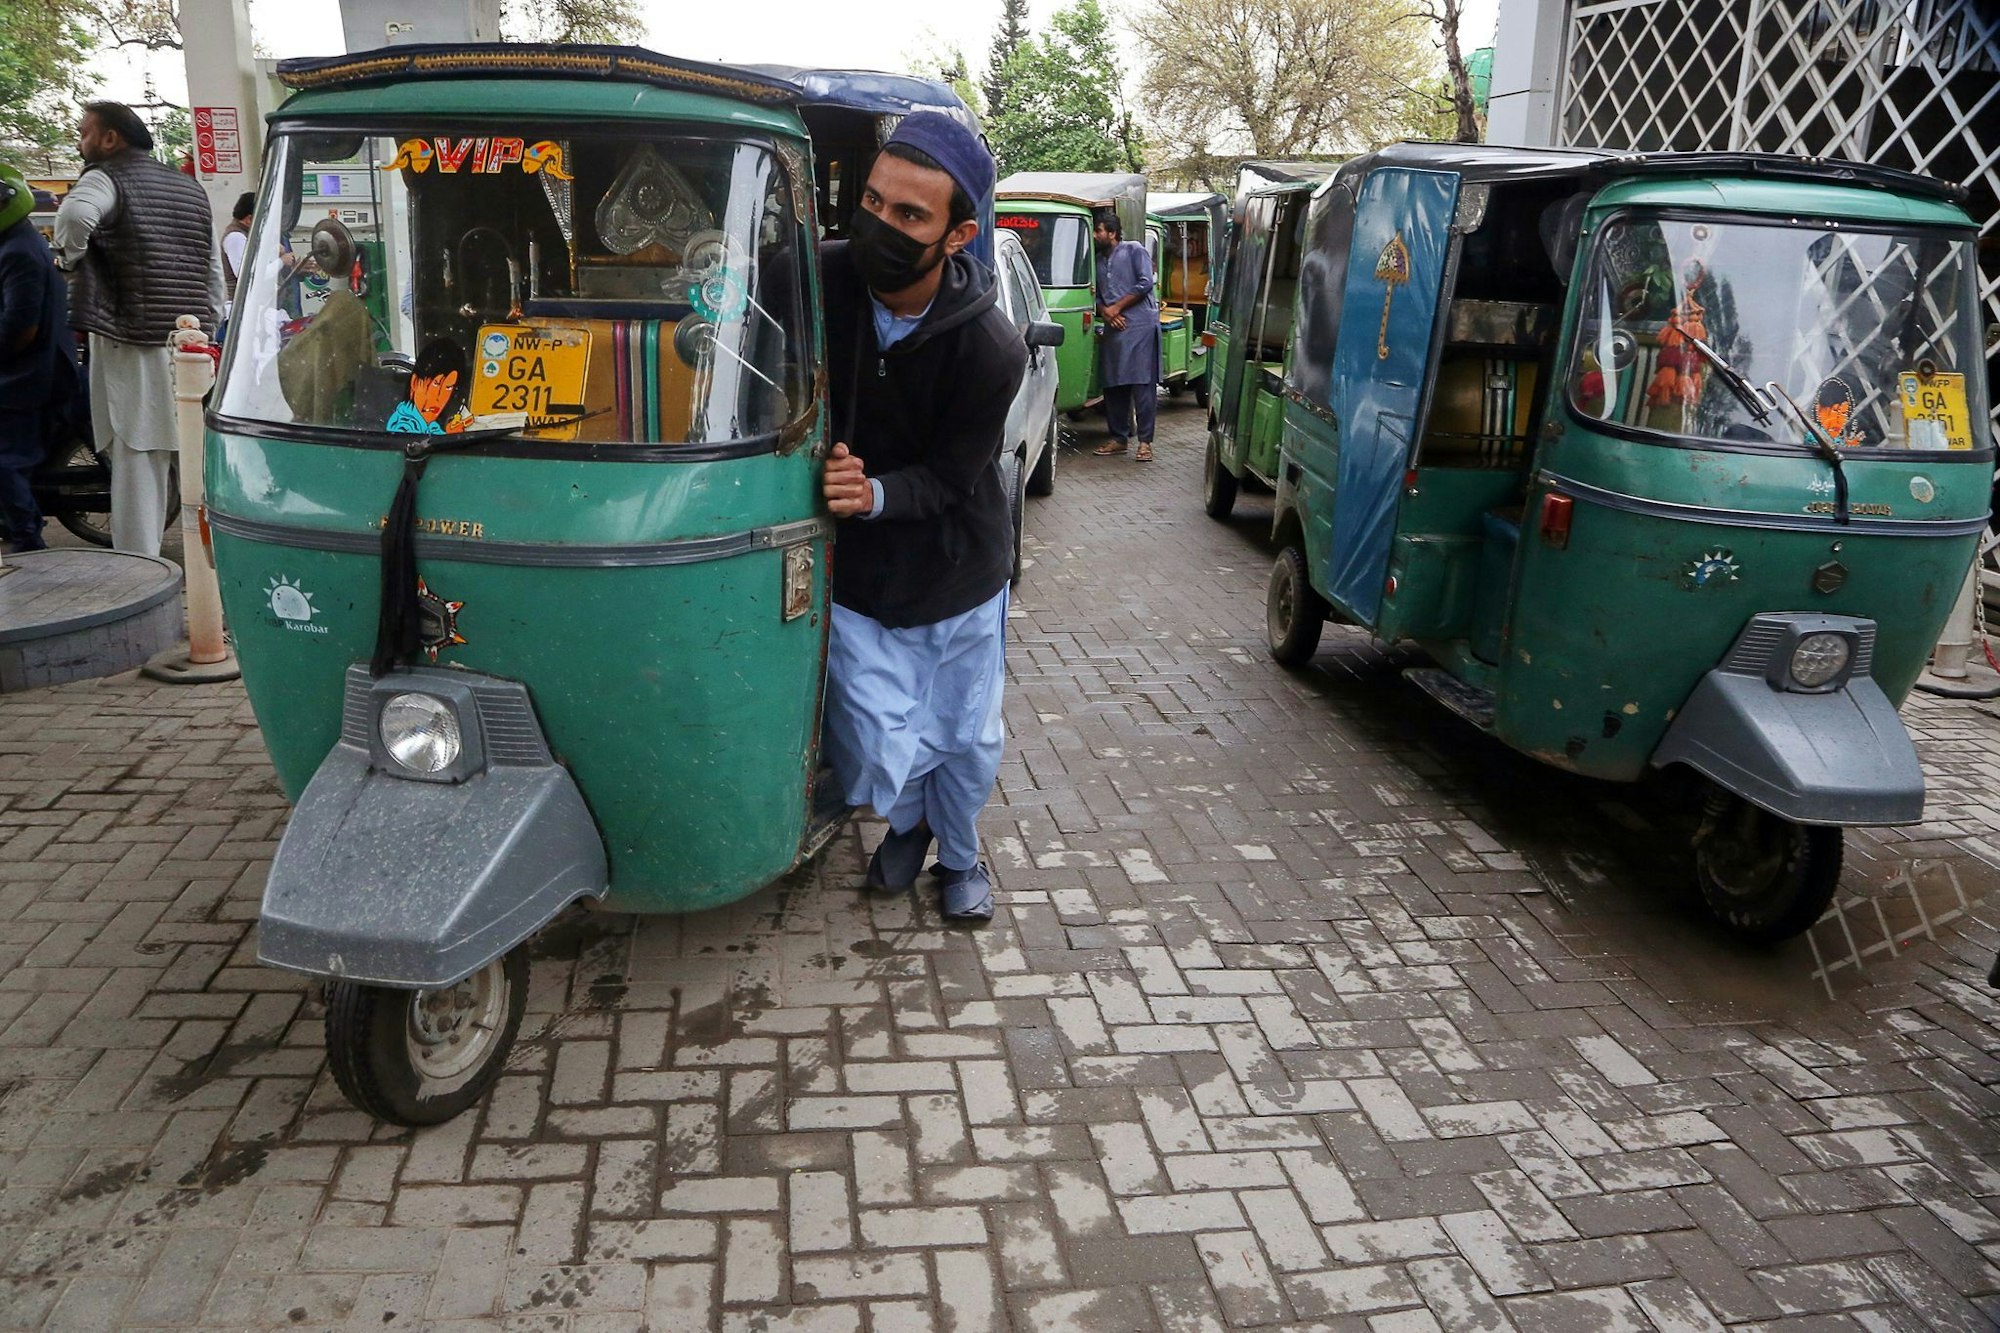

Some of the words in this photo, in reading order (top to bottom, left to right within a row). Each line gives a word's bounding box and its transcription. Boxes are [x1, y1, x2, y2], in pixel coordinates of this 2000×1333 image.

[434, 137, 524, 173] VIP
[514, 338, 562, 351] NWP
[508, 356, 546, 381] GA
[491, 383, 552, 414] 2311
[1922, 391, 1947, 410] GA
[285, 620, 328, 634] Karobar
